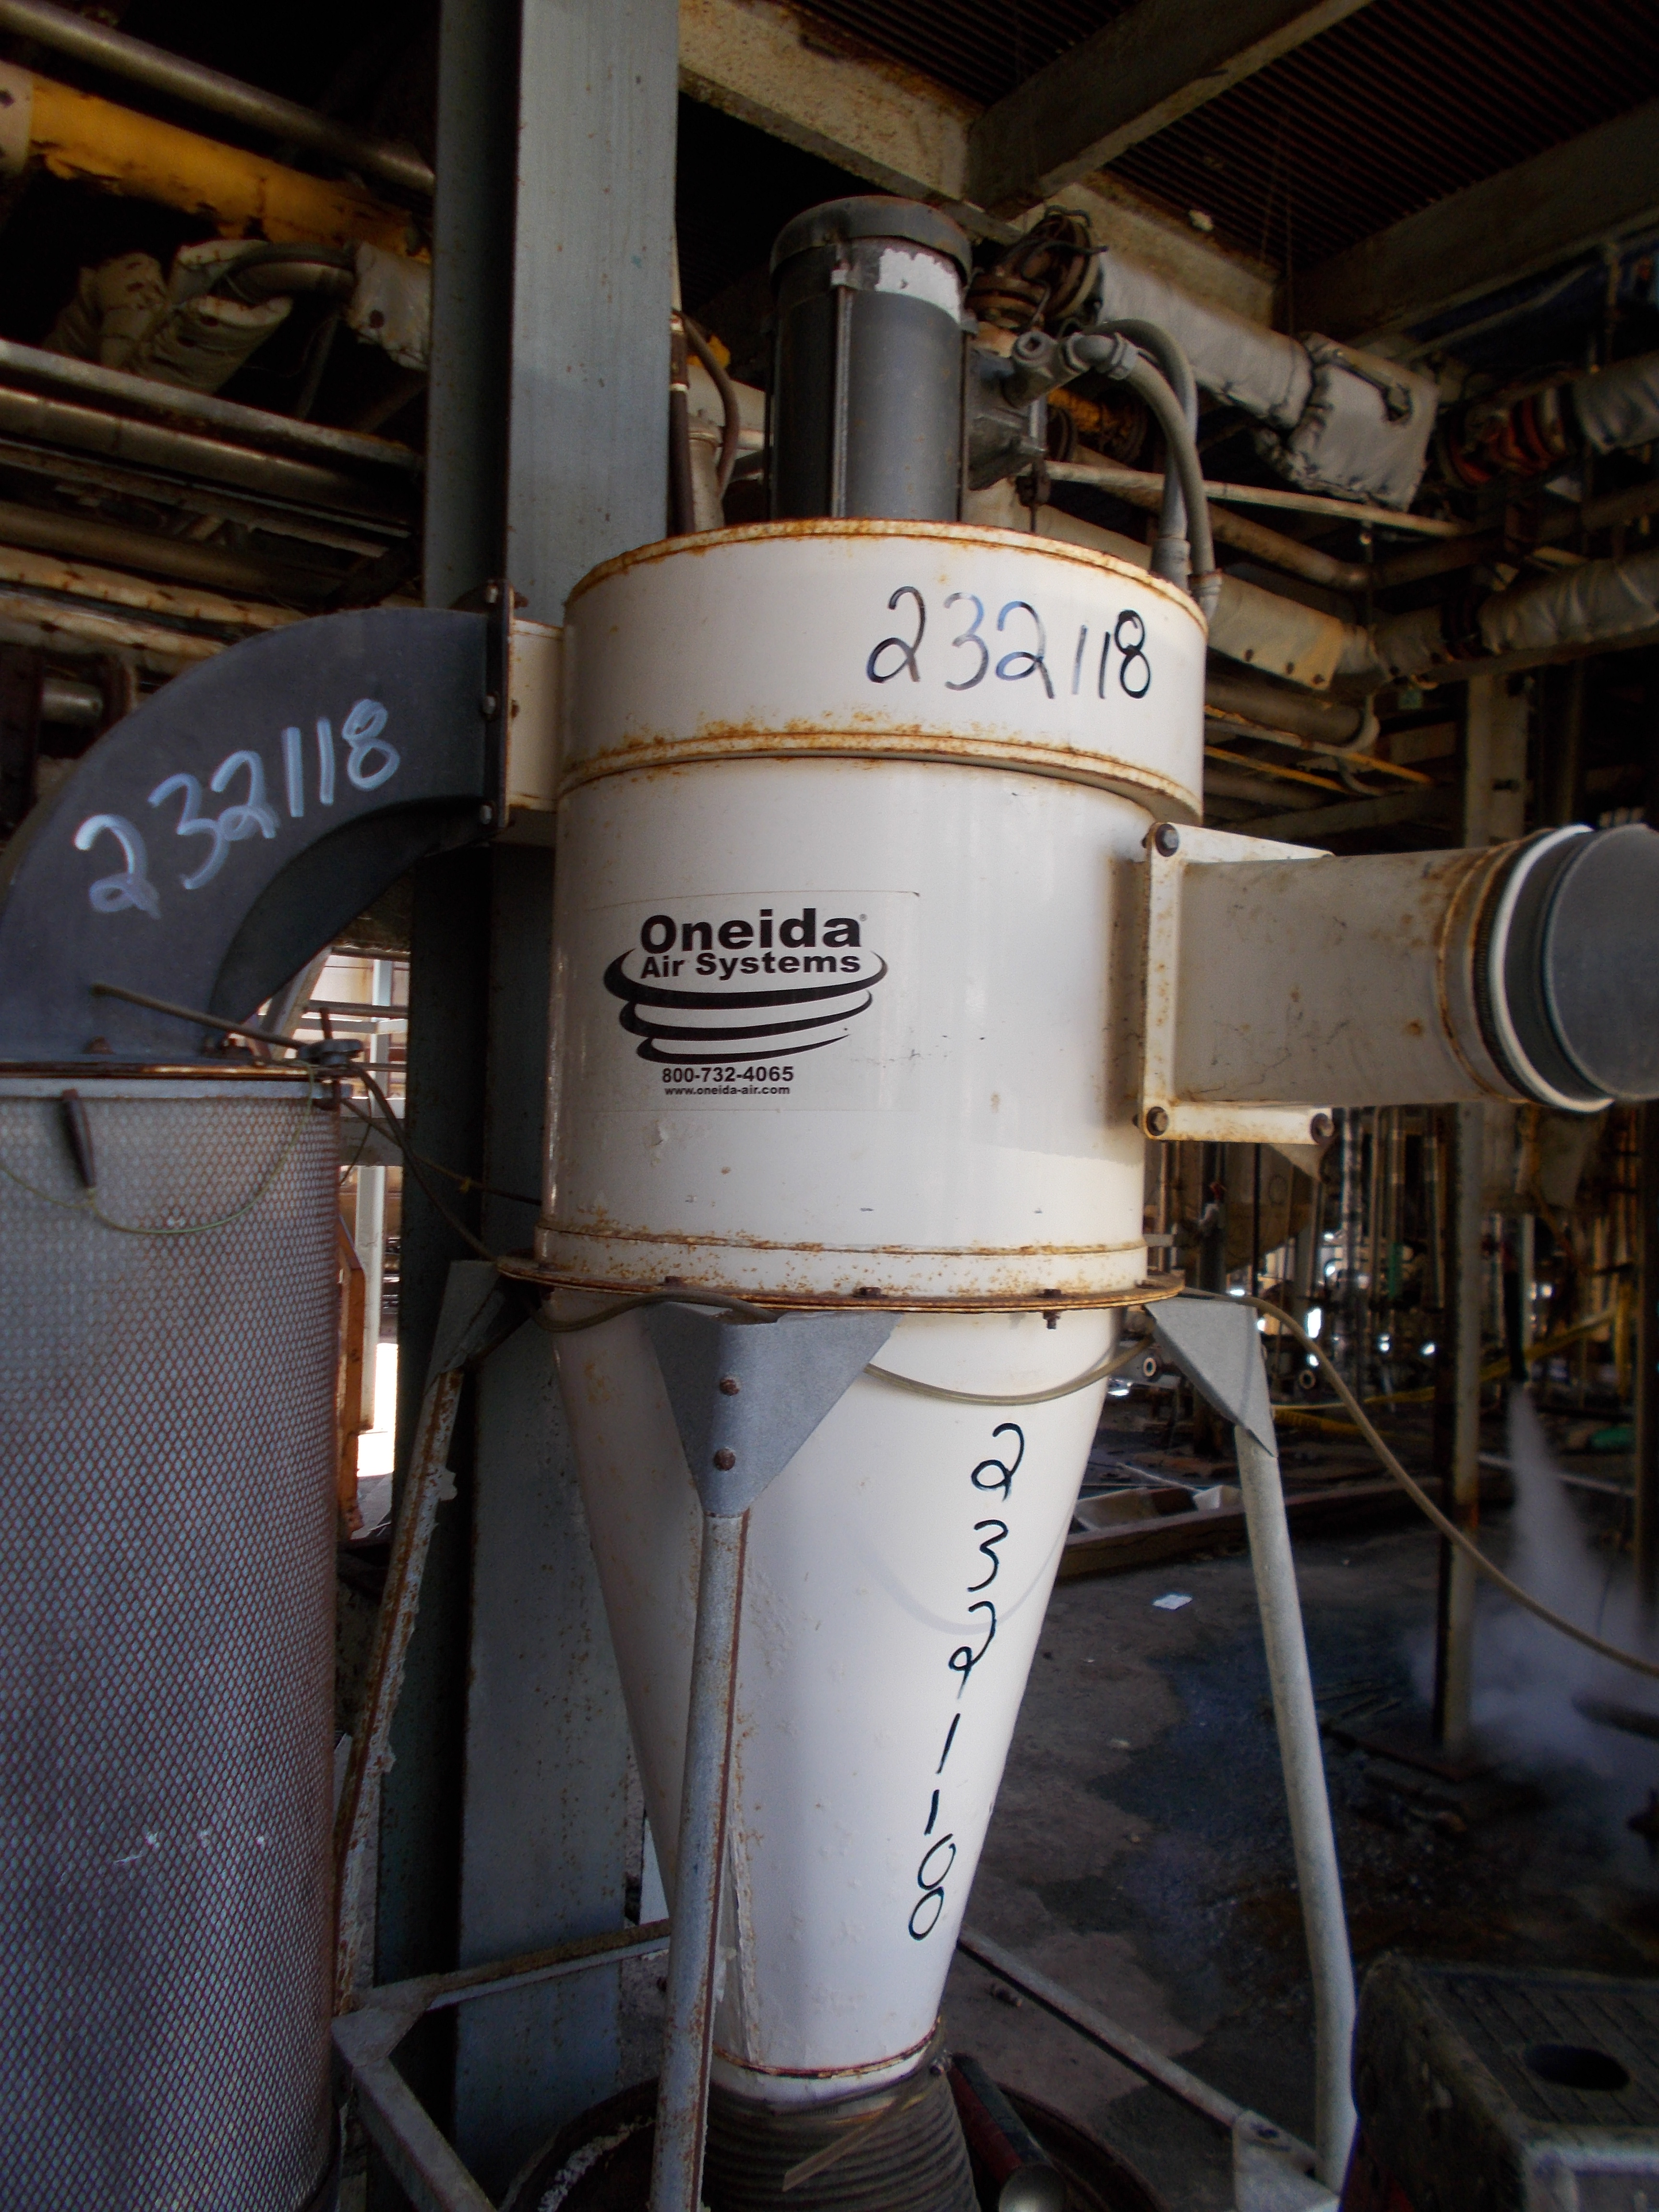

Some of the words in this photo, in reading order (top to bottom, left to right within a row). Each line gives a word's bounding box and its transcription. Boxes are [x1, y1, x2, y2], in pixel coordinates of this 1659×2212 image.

[866, 586, 1152, 699] 232118
[72, 698, 400, 920] 232118
[640, 908, 862, 954] Oneida
[640, 956, 685, 979] Air
[696, 951, 861, 980] Systems
[662, 1066, 794, 1083] 800-732-4065
[664, 1084, 791, 1095] www.oneida-air.com
[908, 1422, 1025, 1941] 232118
